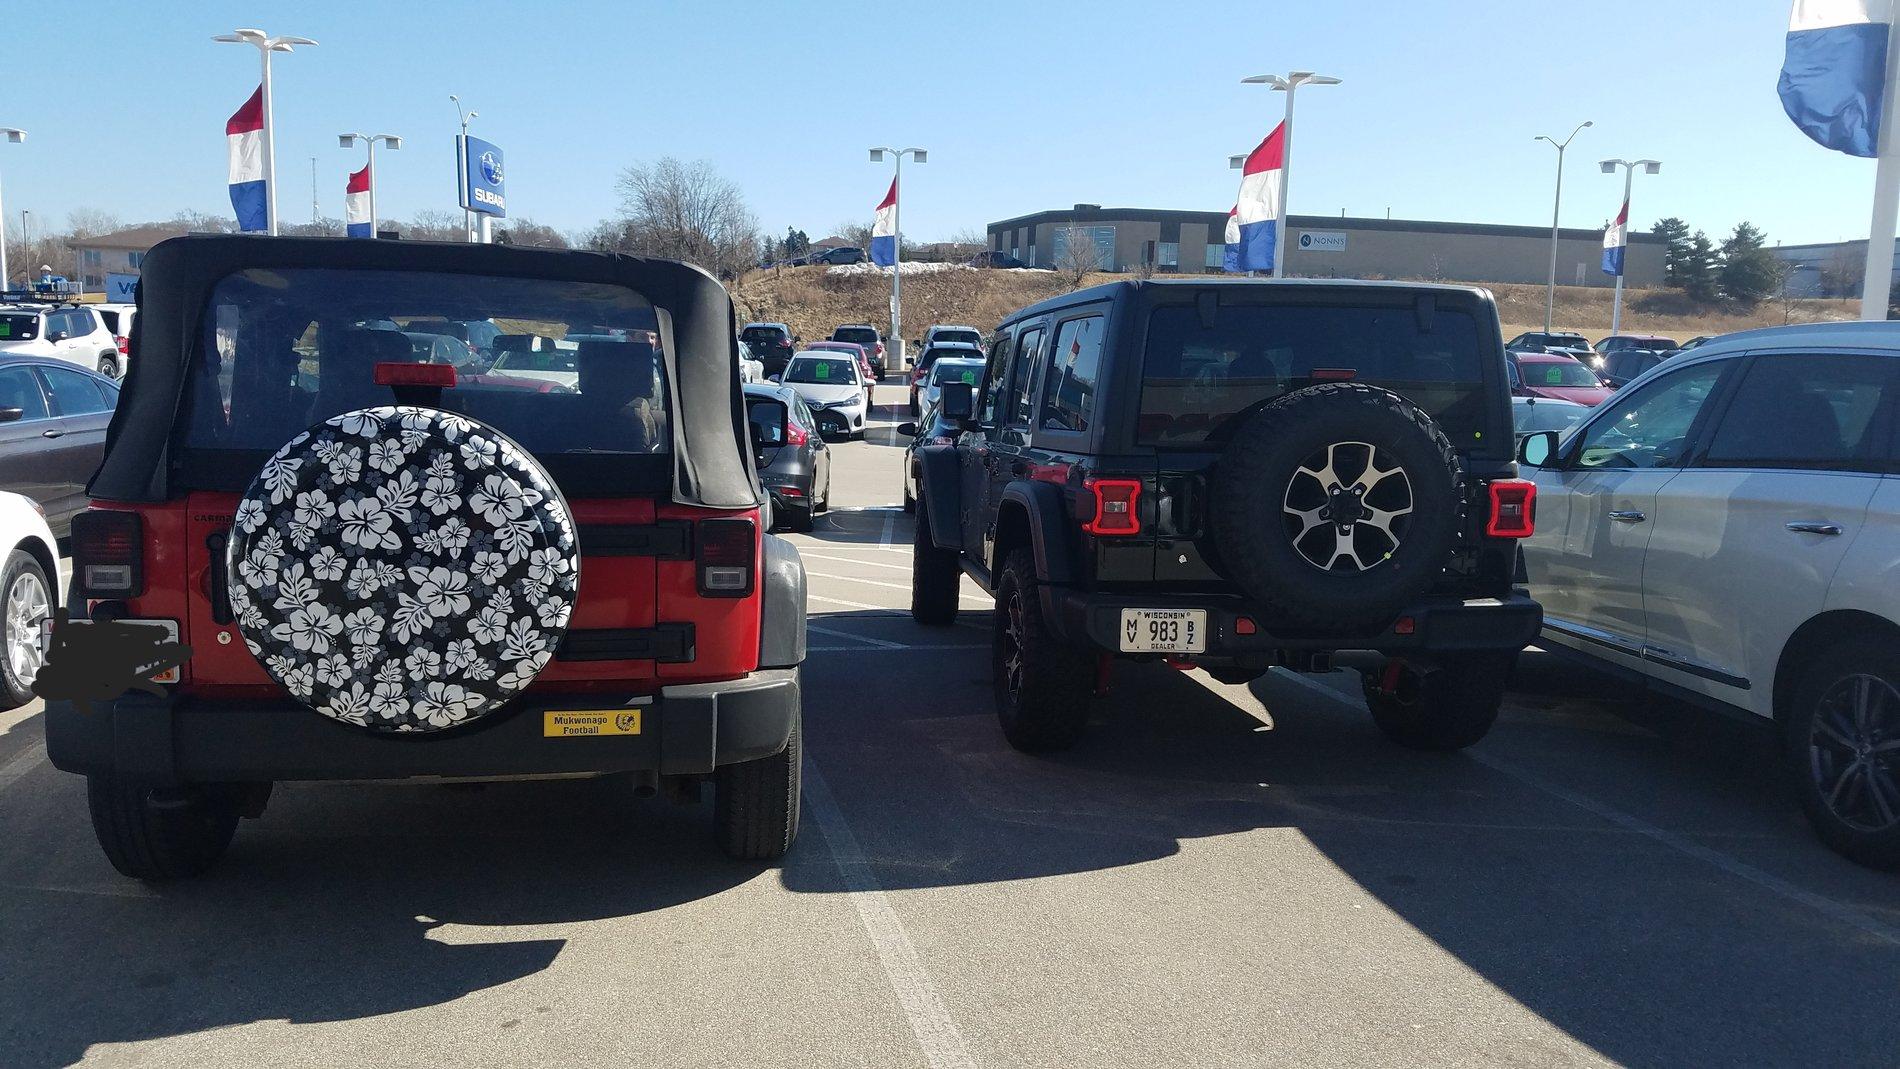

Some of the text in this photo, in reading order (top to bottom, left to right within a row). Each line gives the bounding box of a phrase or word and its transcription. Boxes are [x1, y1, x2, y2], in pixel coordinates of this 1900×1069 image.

[1149, 620, 1178, 641] 983
[554, 717, 608, 725] Mukwonago
[563, 726, 599, 735] Football
